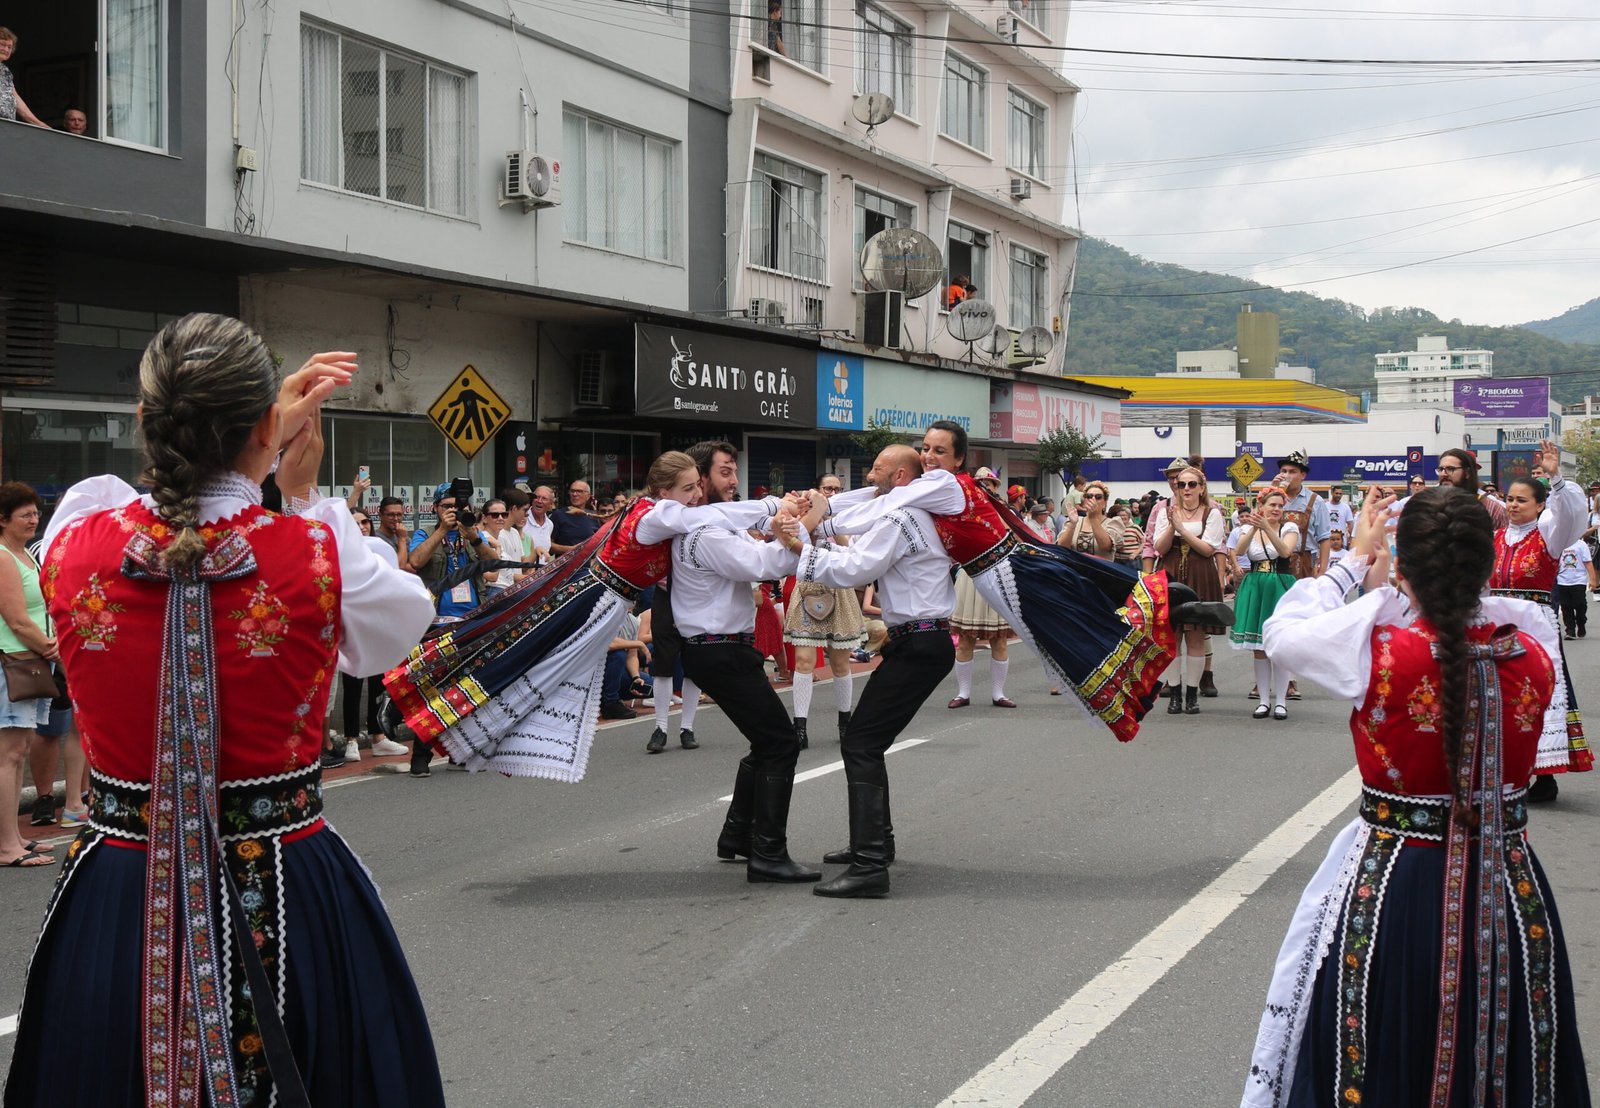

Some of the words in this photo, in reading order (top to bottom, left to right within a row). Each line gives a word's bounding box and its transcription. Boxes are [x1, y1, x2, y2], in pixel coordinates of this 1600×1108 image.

[960, 309, 989, 319] vivo
[687, 361, 747, 391] SANTO
[753, 367, 797, 397] GRÃO
[828, 392, 853, 408] loterias
[760, 400, 790, 419] CAFÉ
[828, 408, 853, 424] CAIXA
[875, 404, 918, 428] LOTÉRICA
